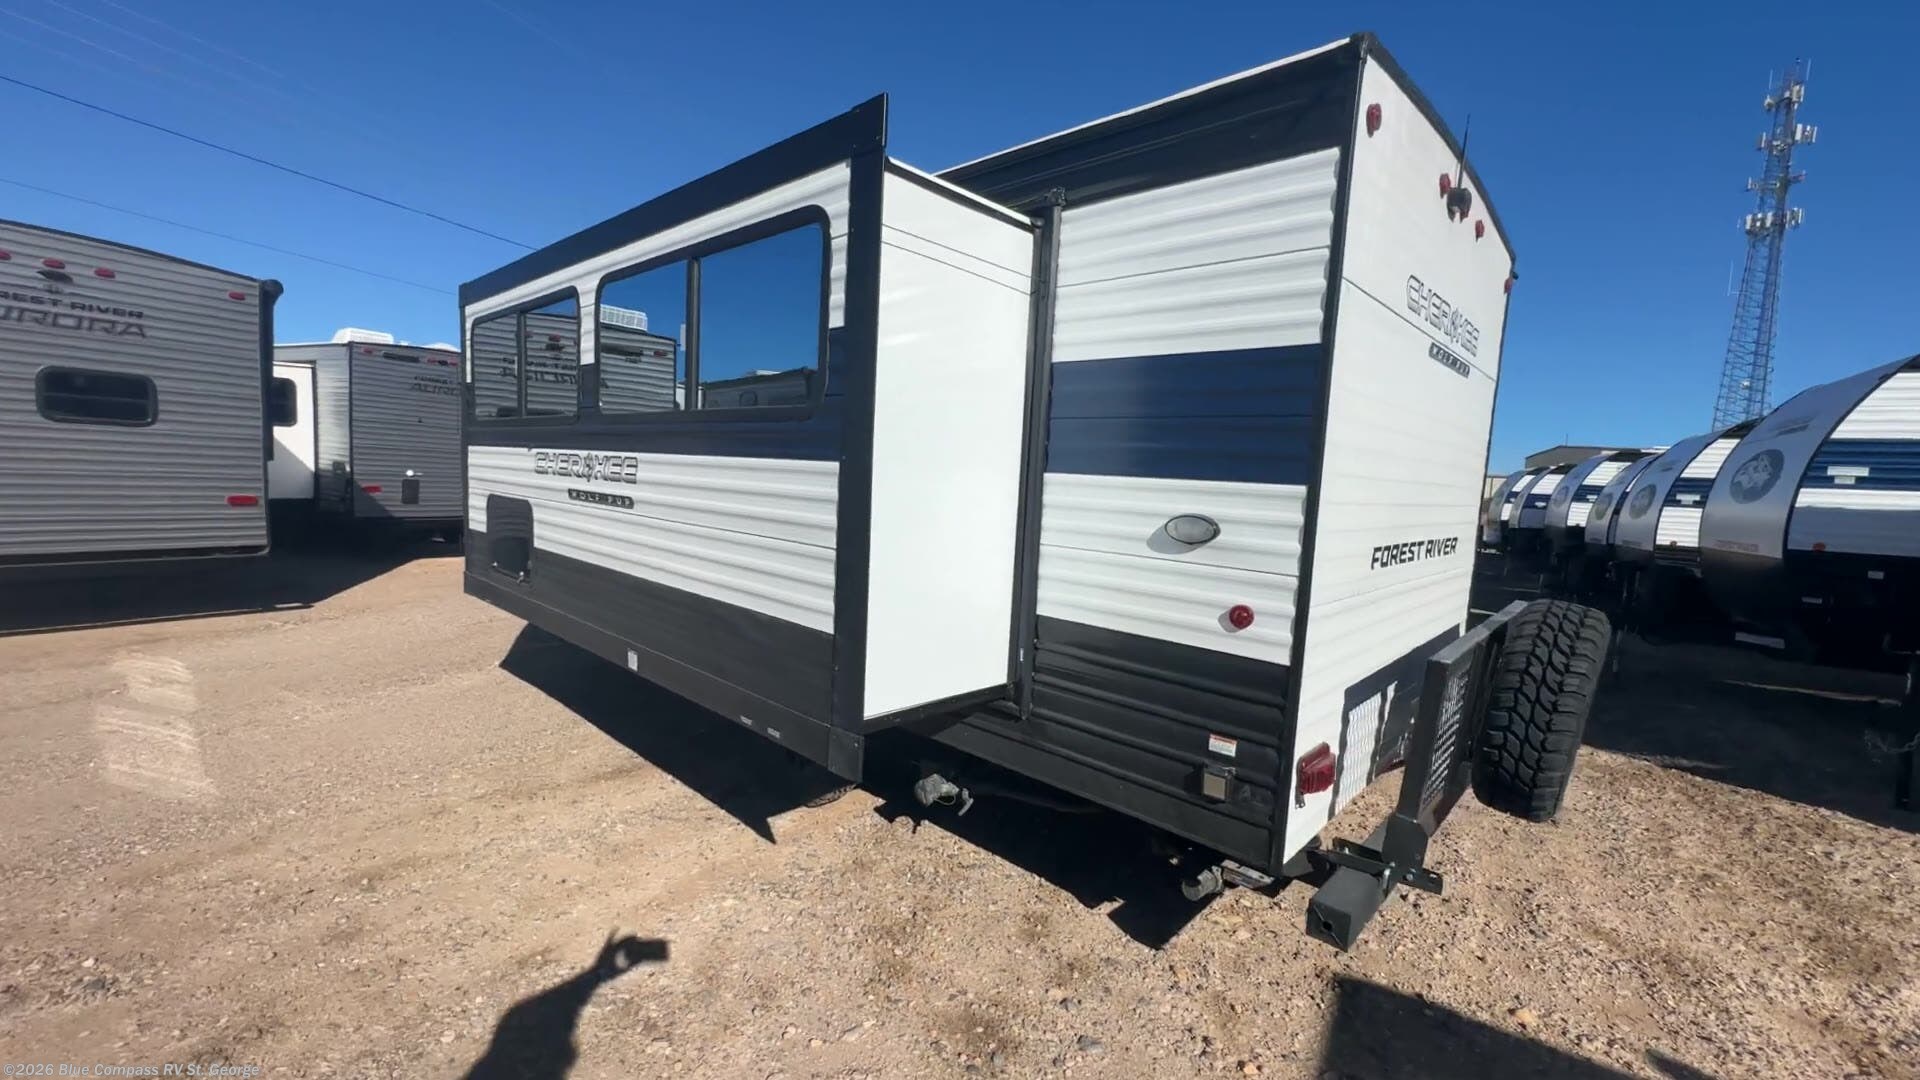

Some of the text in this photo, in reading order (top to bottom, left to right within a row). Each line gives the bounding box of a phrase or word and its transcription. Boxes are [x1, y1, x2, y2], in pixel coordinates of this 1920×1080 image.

[70, 301, 144, 319] RIVER
[1406, 274, 1480, 358] CHEROKEE
[535, 452, 638, 484] CHEROKEE
[1371, 536, 1458, 570] FOREST RIVER
